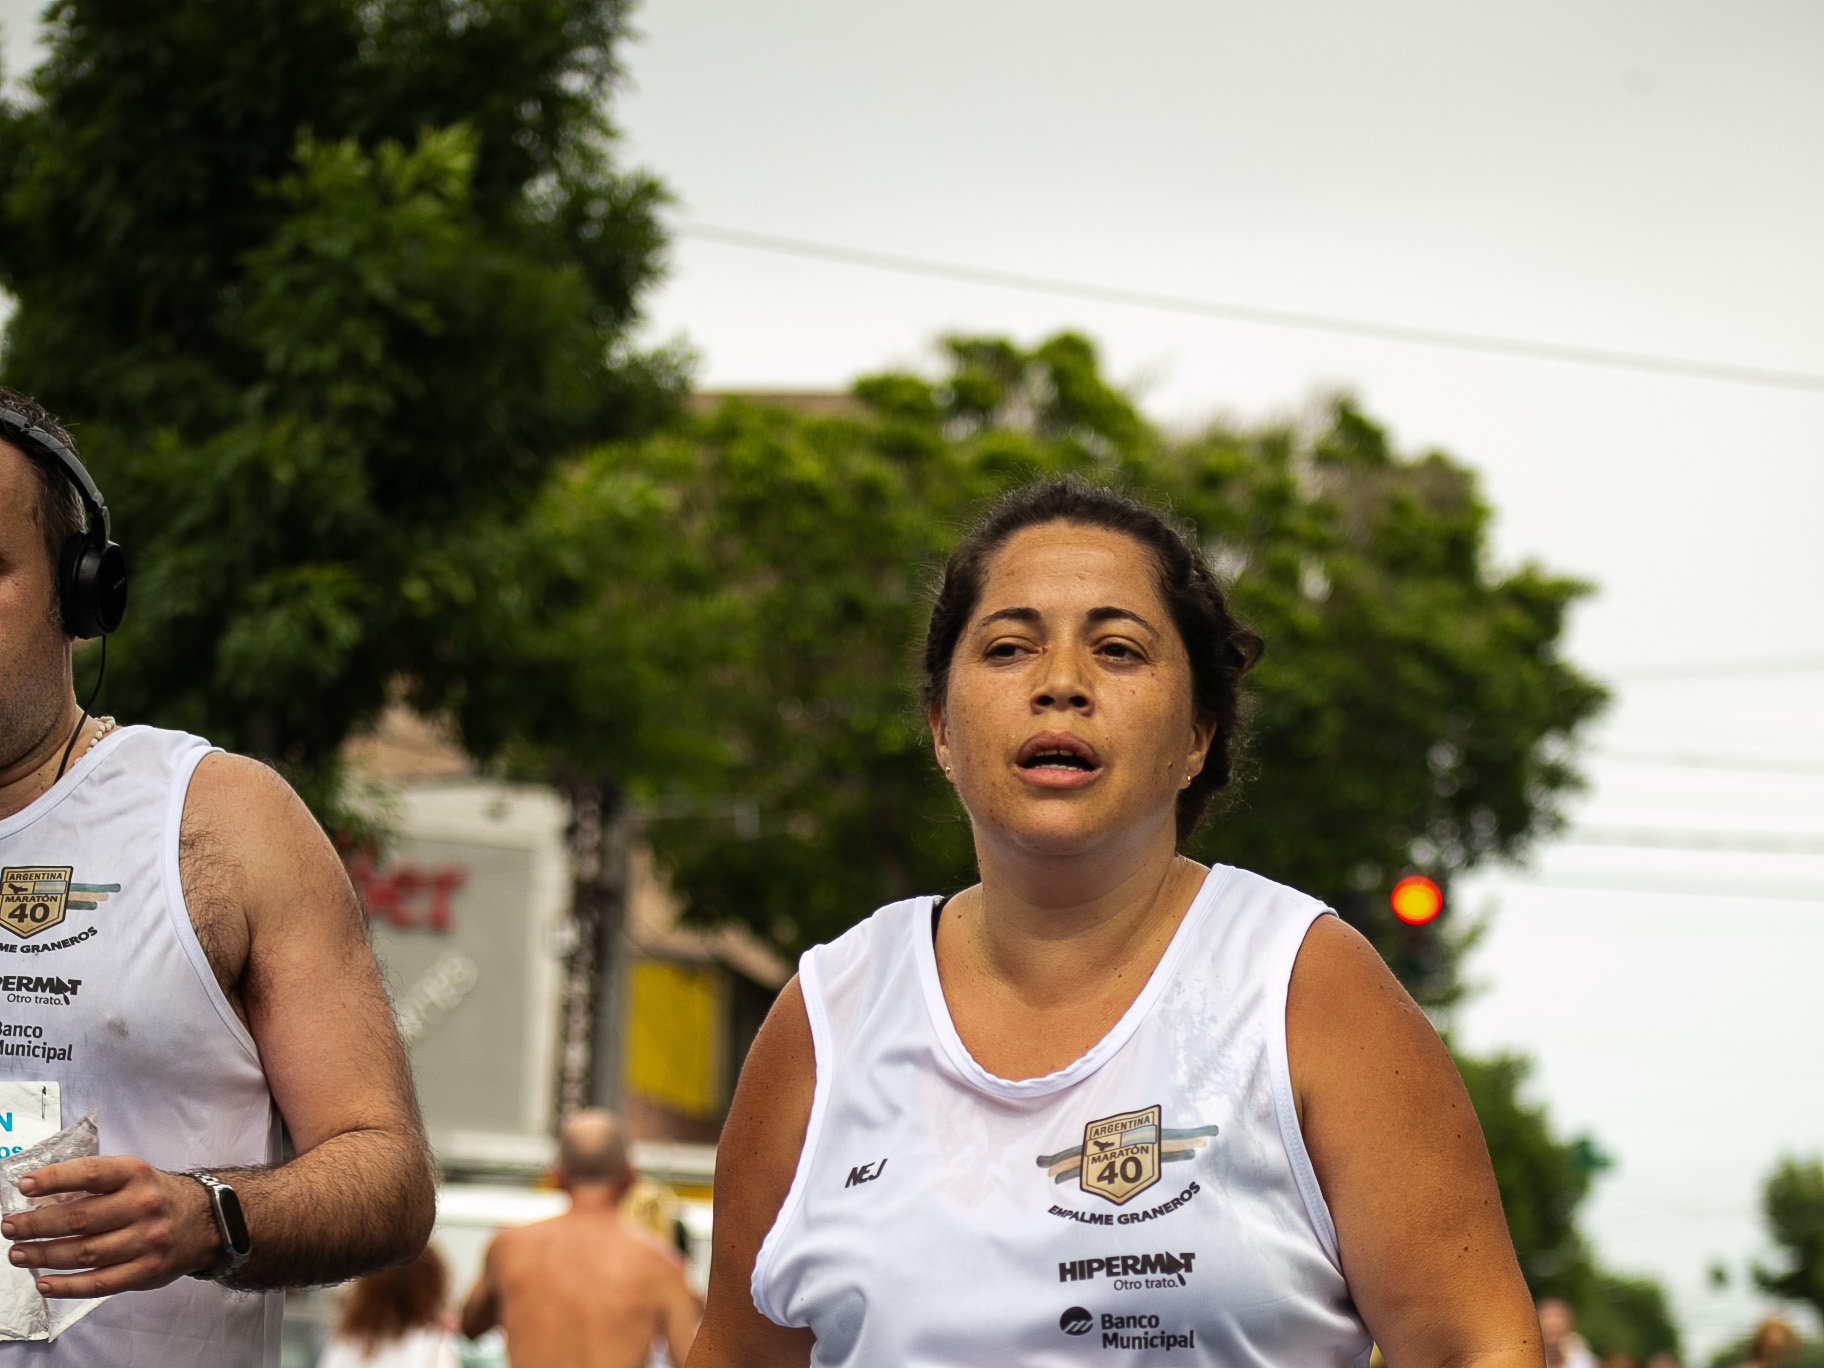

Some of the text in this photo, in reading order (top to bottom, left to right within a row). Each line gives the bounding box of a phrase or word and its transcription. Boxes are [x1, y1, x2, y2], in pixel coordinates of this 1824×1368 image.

[9, 872, 63, 881] ARGENTINA
[5, 894, 59, 903] MARATÓN
[8, 903, 50, 923] 40
[20, 926, 98, 954] GRANEROS
[0, 975, 82, 996] ERMAT
[7, 993, 64, 1006] Otro trato.
[0, 1021, 43, 1039] anco
[1092, 1115, 1151, 1138] ARGENTINA
[1090, 1144, 1150, 1165] MARATÓN
[1096, 1156, 1143, 1185] 40
[1047, 1180, 1201, 1226] EMPALME GRANEROS
[1058, 1251, 1196, 1283] HIPERMAT
[1113, 1277, 1179, 1291] Otro trato.
[1100, 1313, 1160, 1331] Banco
[1102, 1329, 1196, 1352] Municipal
